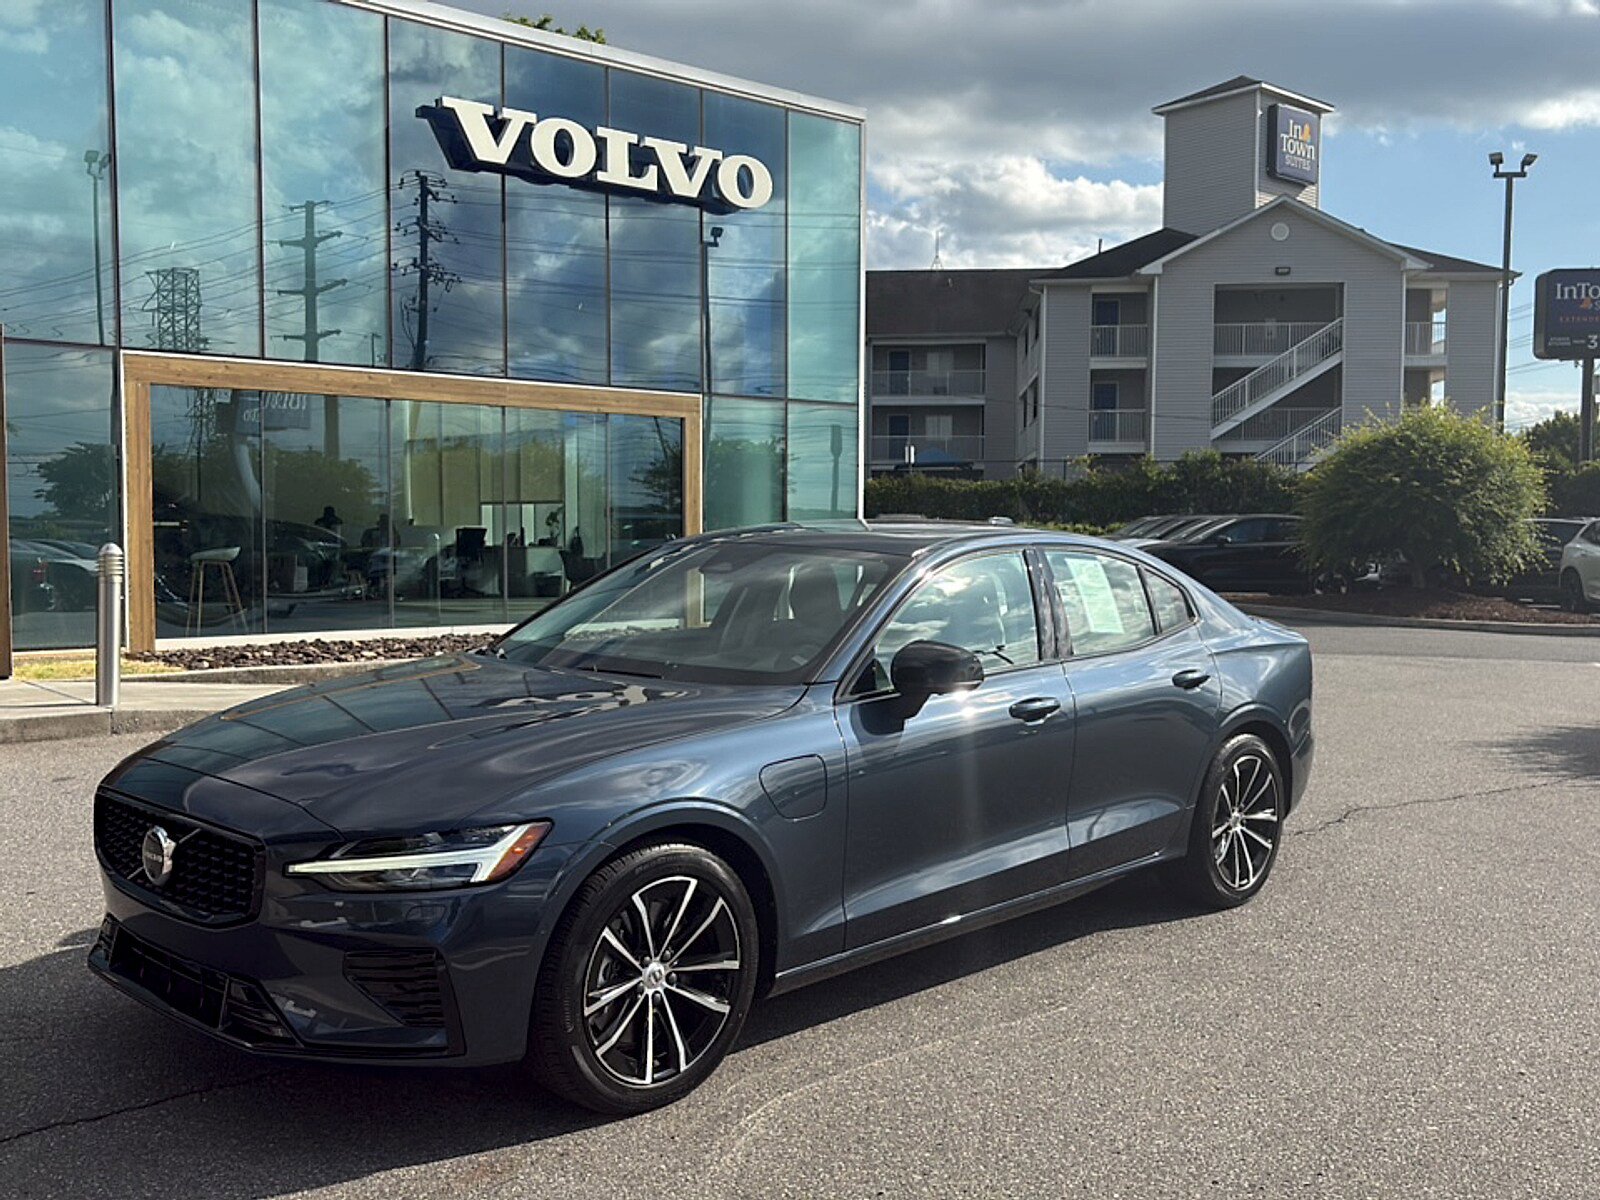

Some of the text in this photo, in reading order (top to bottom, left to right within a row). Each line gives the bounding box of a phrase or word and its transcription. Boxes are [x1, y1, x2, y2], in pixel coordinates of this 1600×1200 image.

[1289, 119, 1303, 140] In
[441, 96, 774, 209] VOLVO
[1280, 133, 1315, 160] Town
